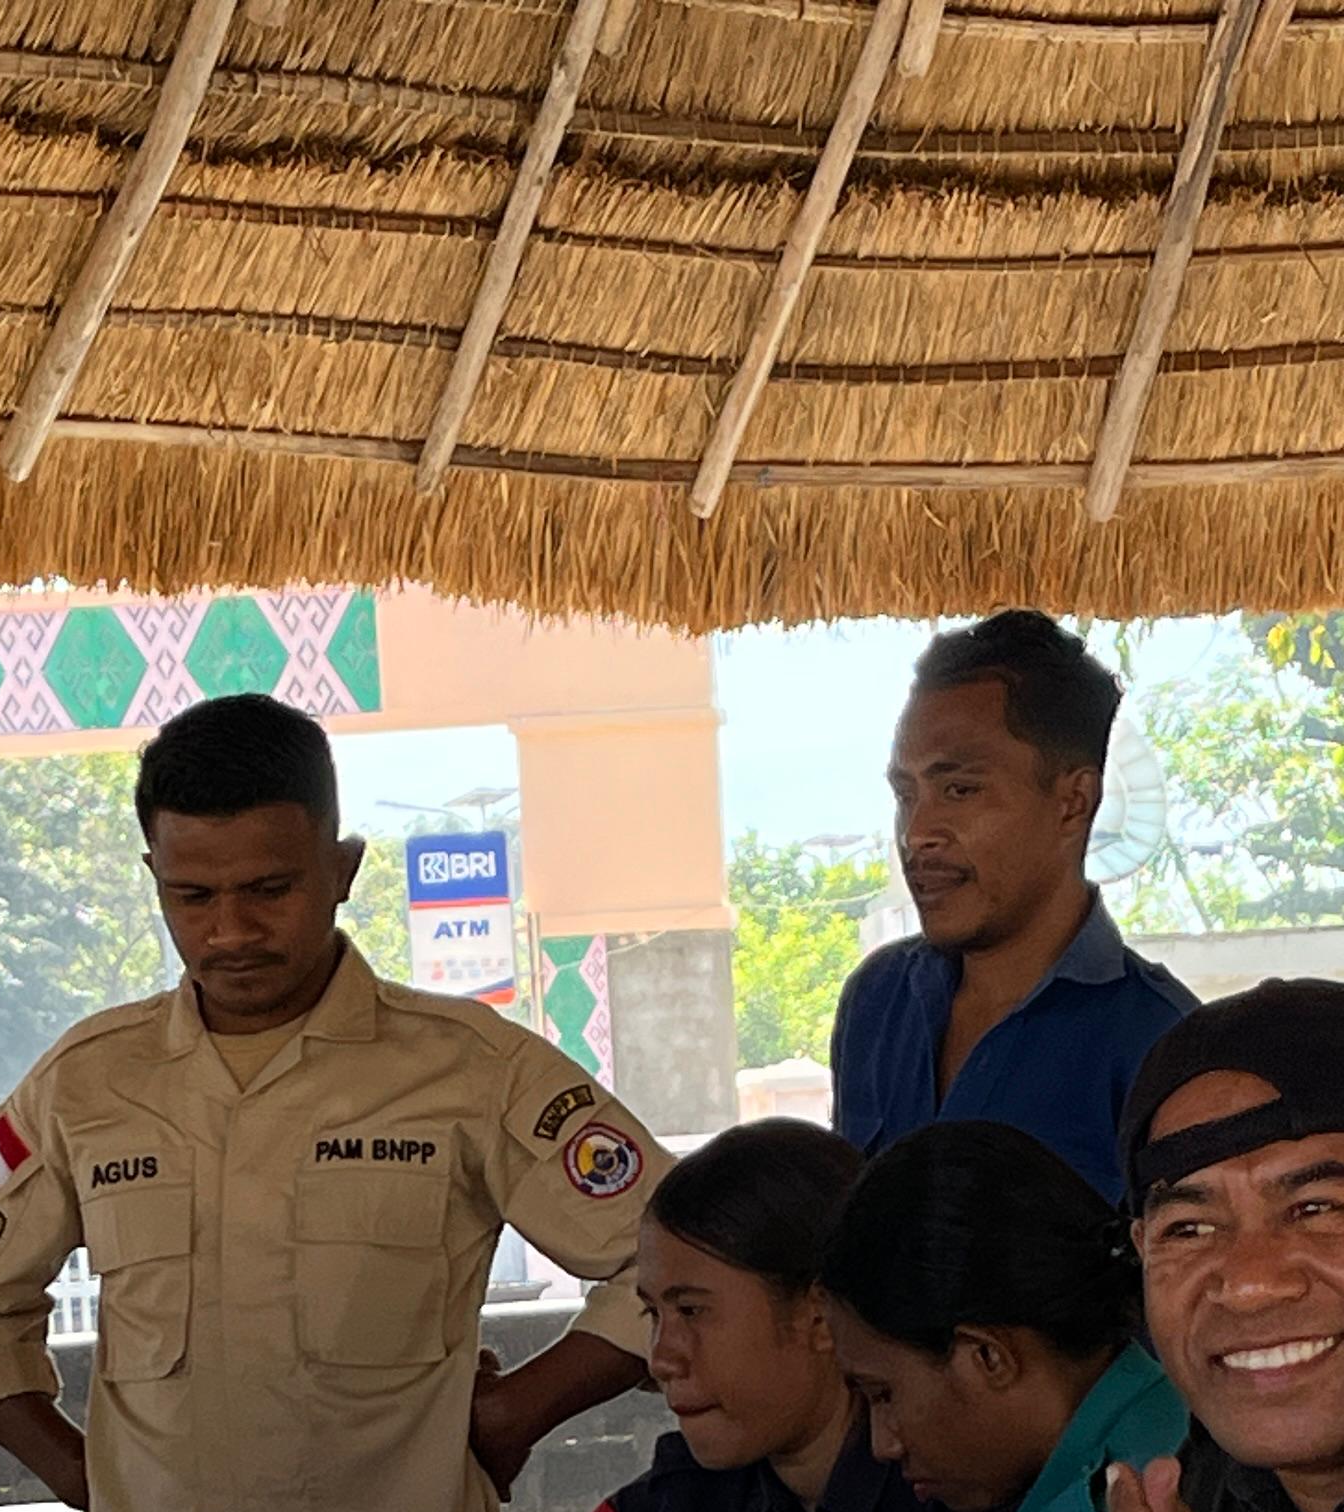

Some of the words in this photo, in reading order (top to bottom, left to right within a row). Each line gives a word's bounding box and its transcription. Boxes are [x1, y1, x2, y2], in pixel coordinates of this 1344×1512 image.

[450, 852, 496, 879] BRI
[434, 919, 490, 940] ATM
[316, 1138, 363, 1163] PAM
[372, 1138, 436, 1165] BNPP
[92, 1156, 158, 1189] AGUS
